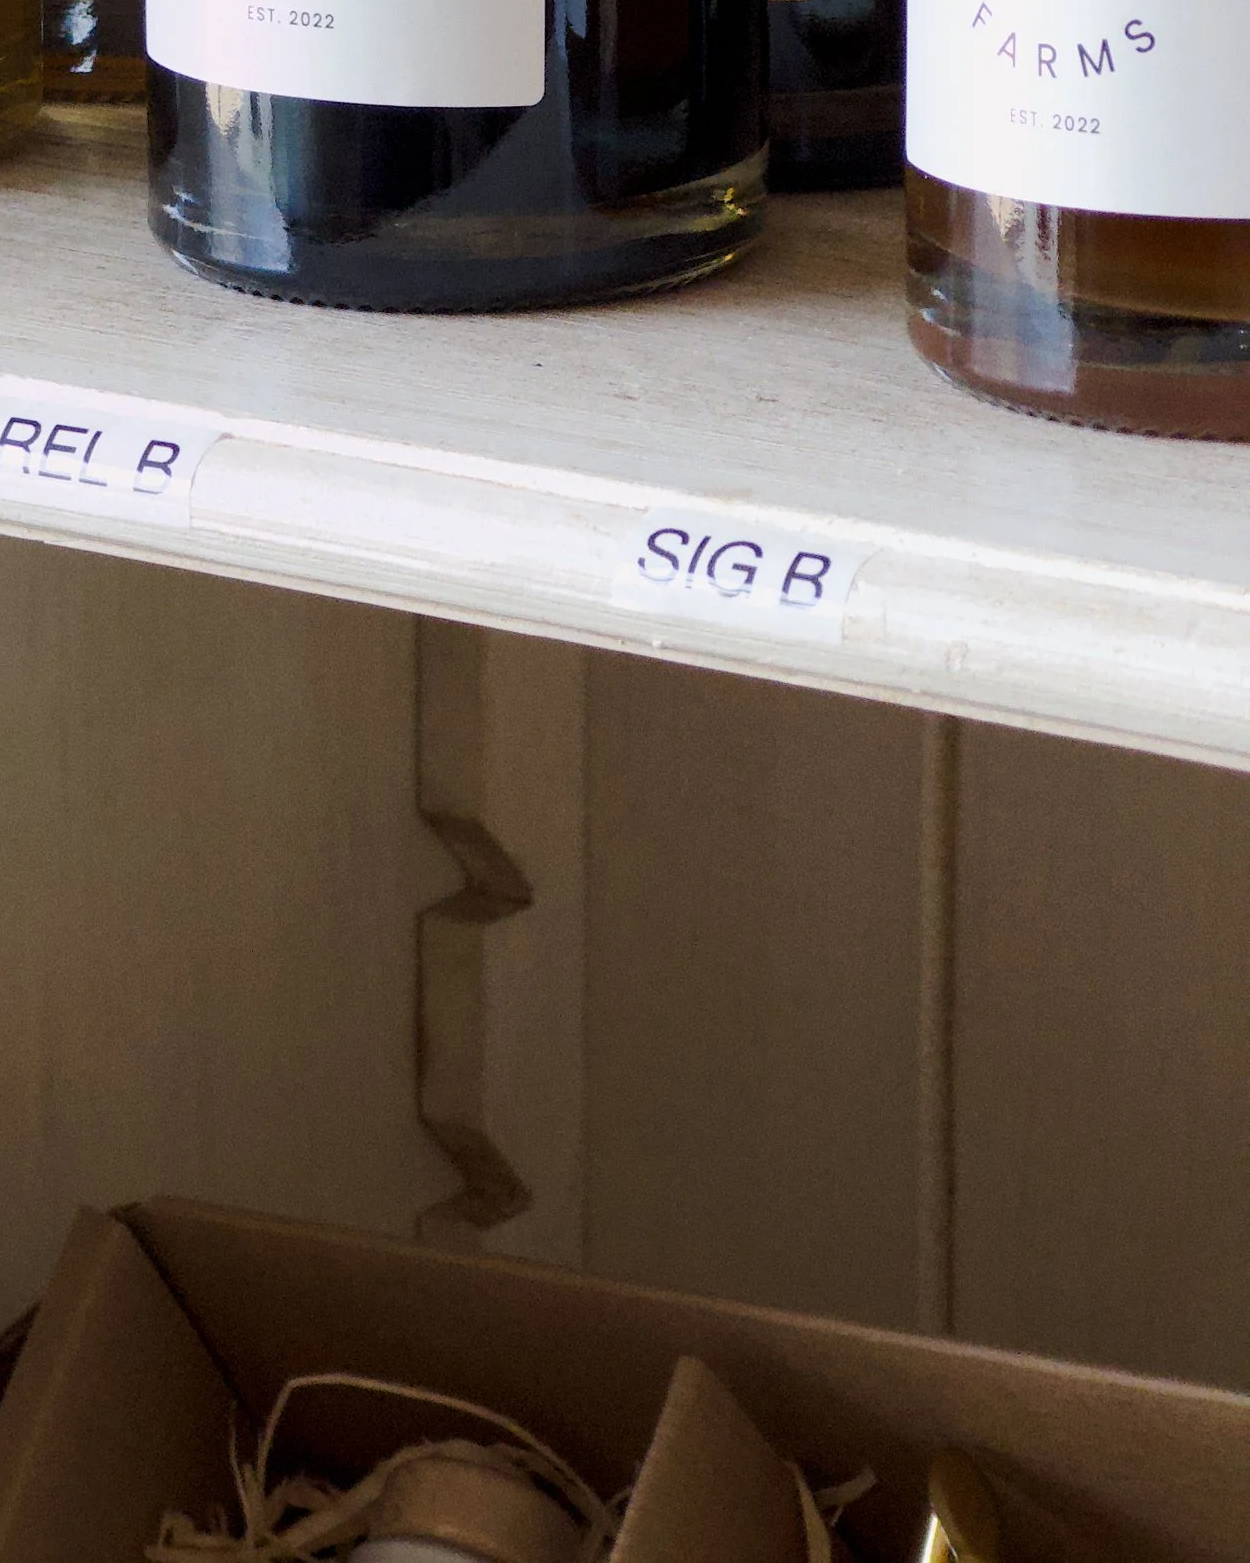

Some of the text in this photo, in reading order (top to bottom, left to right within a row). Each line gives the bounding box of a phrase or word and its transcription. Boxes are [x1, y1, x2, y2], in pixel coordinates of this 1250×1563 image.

[247, 5, 334, 29] EST. 2022
[972, 1, 1157, 79] FARMS
[1008, 107, 1100, 134] EST. 2022
[133, 440, 181, 494] B
[638, 528, 831, 608] SIG B
